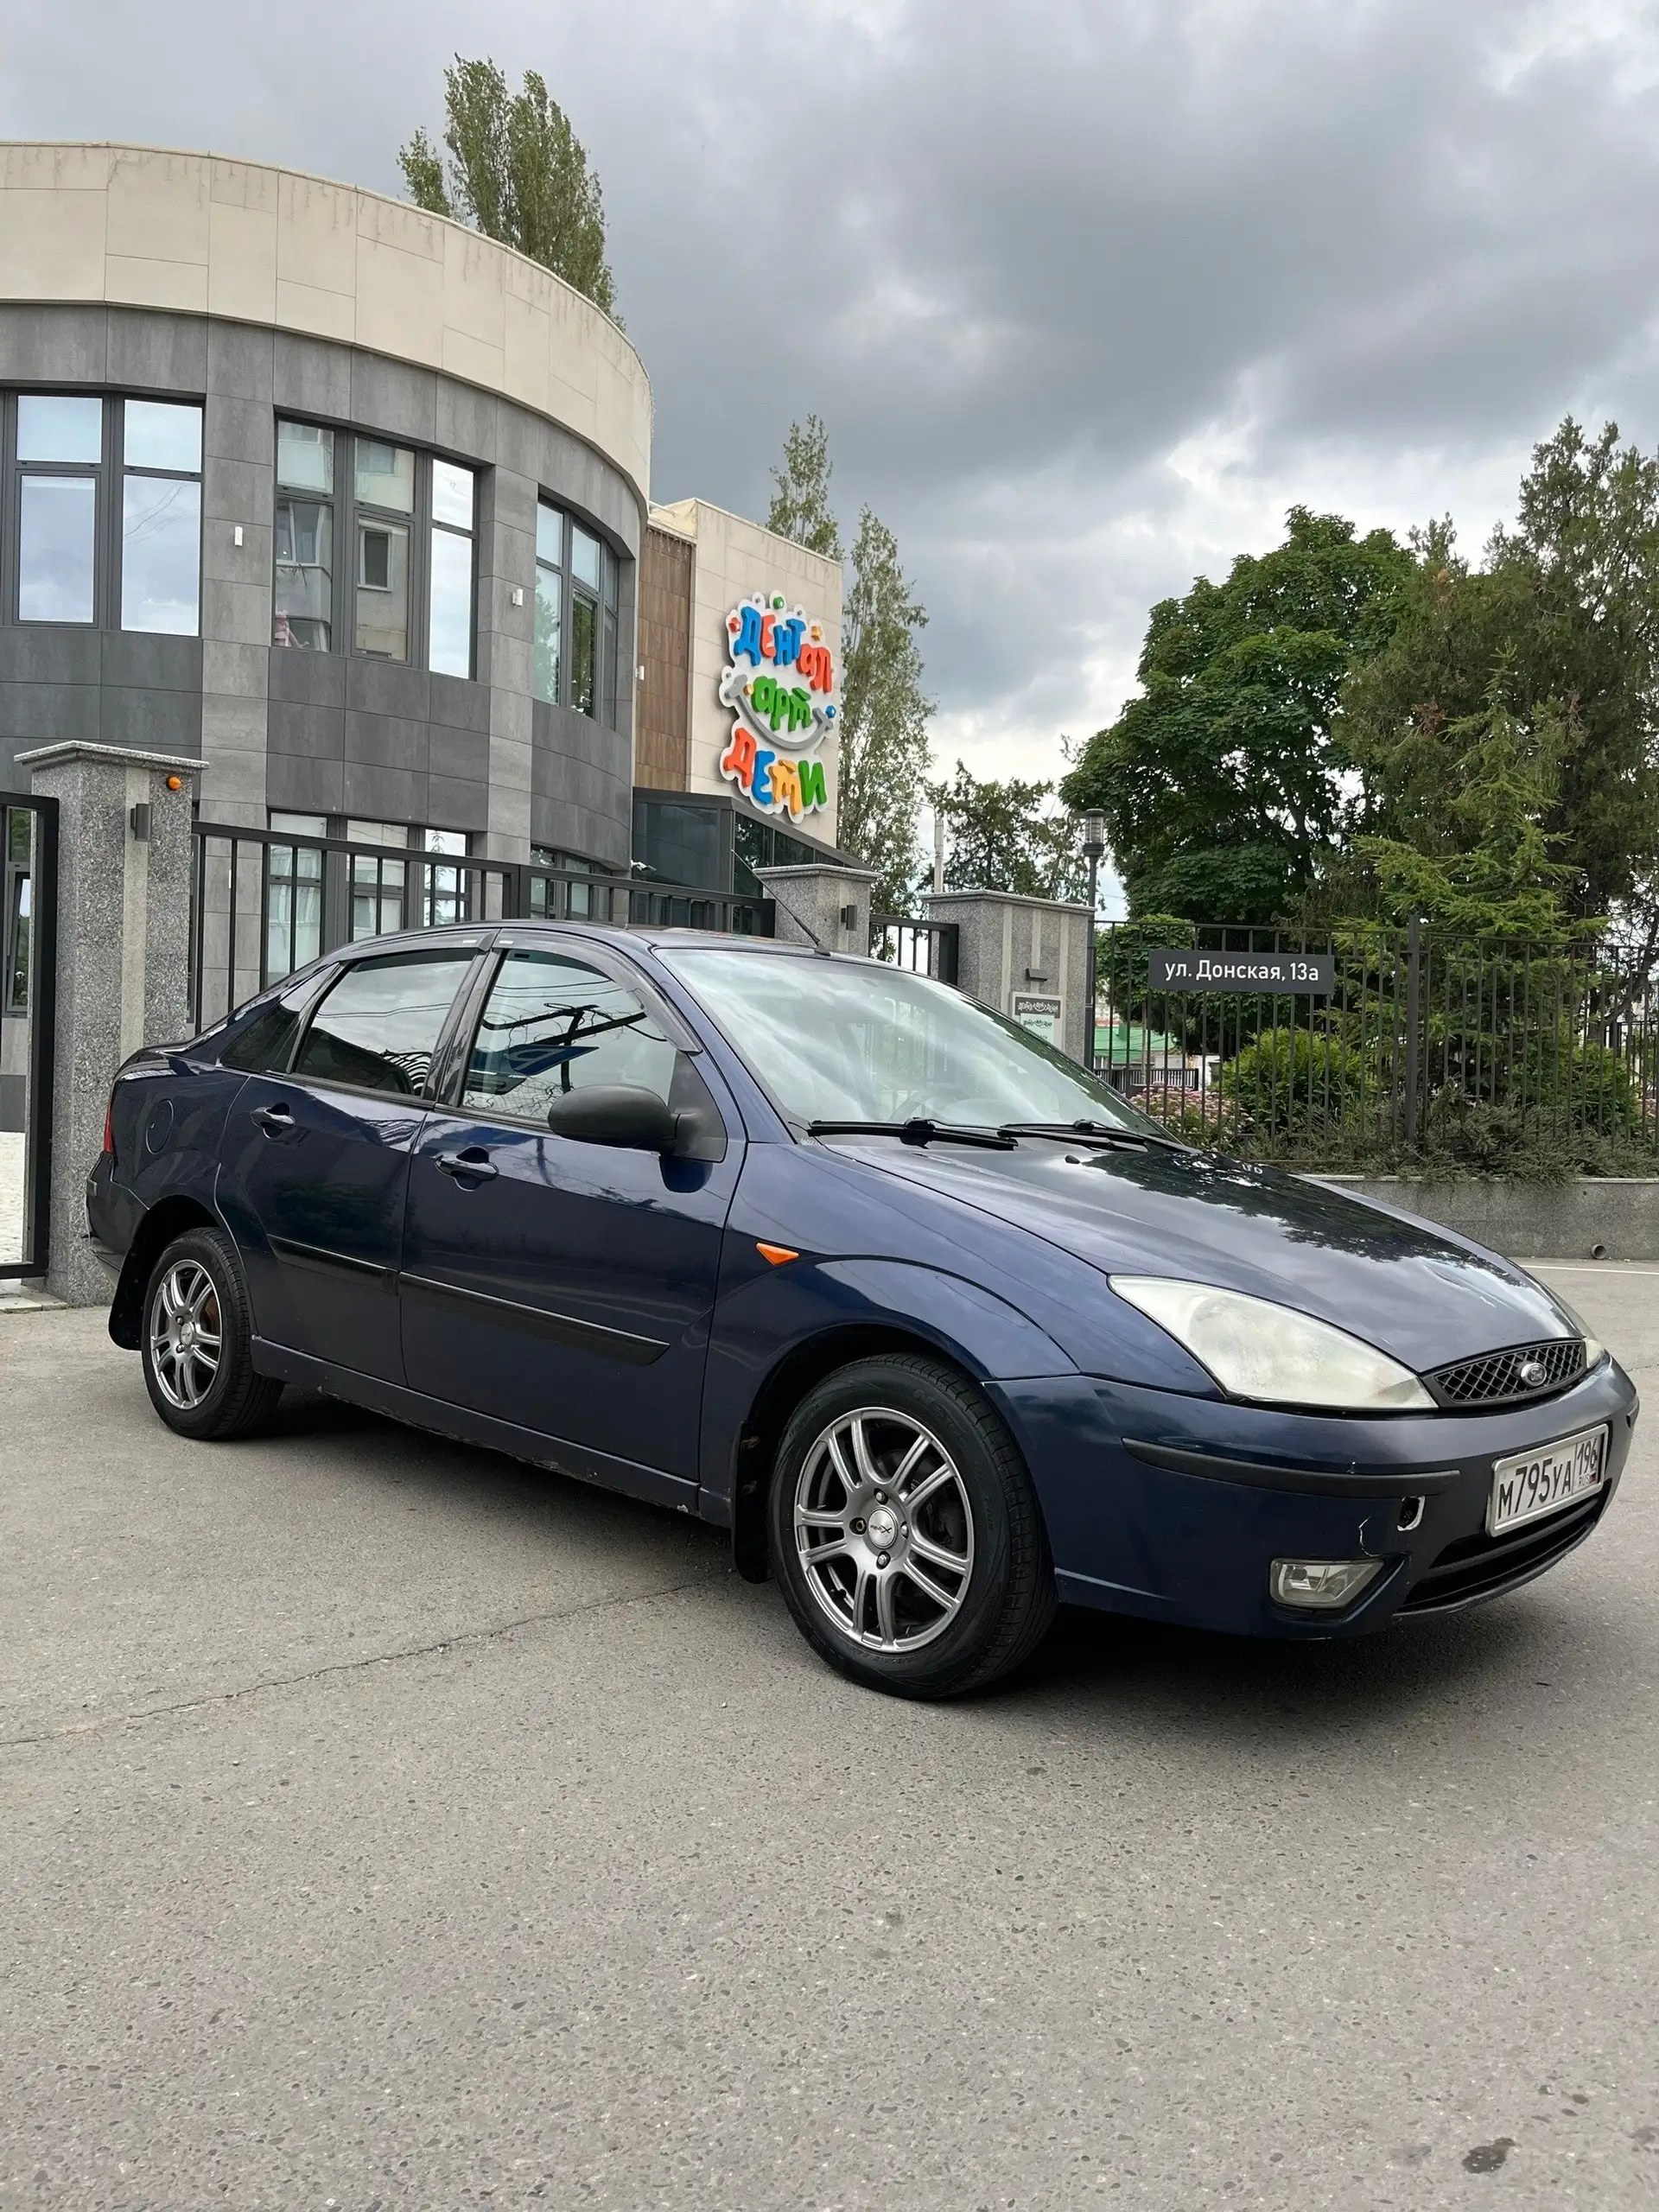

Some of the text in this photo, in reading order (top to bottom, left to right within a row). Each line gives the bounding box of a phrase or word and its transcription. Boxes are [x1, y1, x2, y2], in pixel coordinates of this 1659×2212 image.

[1165, 959, 1319, 982] ул. Донская, 13а
[1497, 1437, 1598, 1520] М795УА 196
